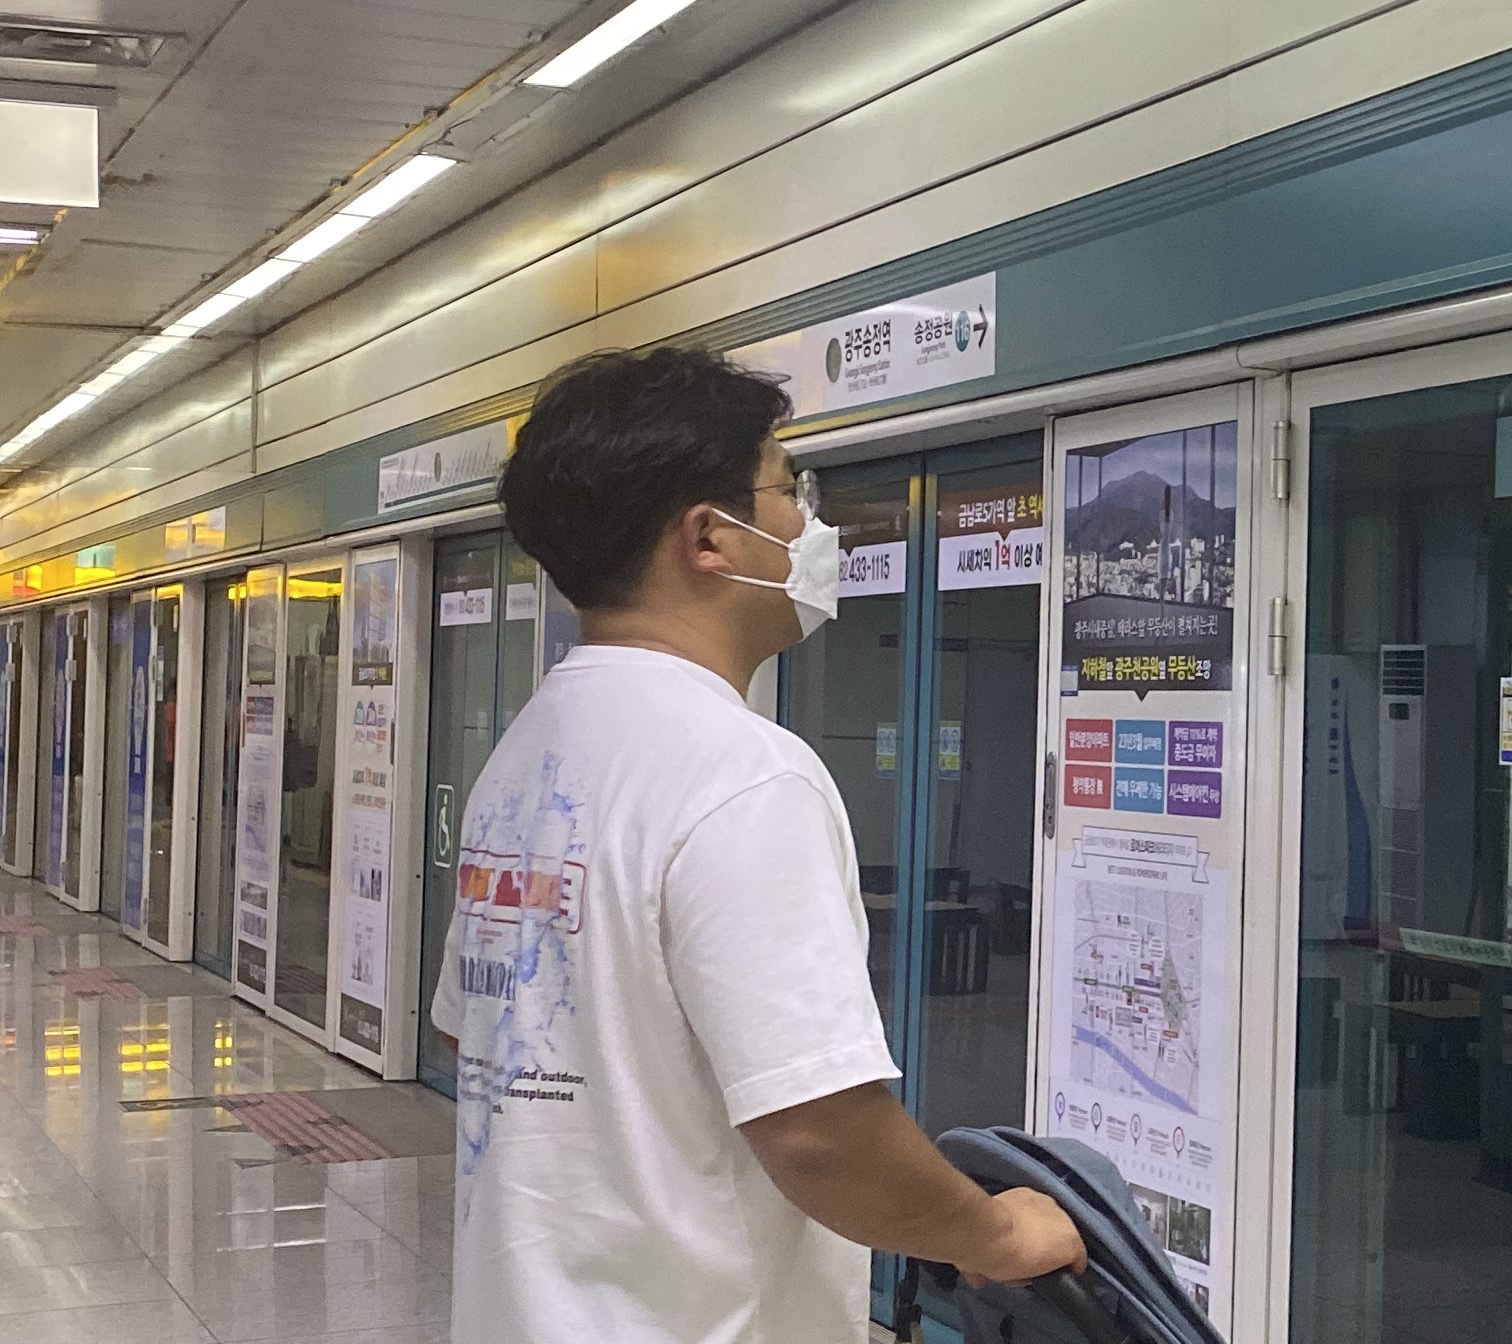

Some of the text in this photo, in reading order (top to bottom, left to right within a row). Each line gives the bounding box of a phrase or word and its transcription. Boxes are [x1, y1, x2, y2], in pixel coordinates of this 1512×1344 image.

[844, 319, 892, 363] 광주송정역
[914, 312, 953, 345] 송정공원
[849, 553, 890, 583] 433-1115
[957, 547, 992, 573] 시세차익
[995, 540, 1011, 571] 1억
[1014, 542, 1033, 568] 이상
[1167, 656, 1212, 681] 무등산조망
